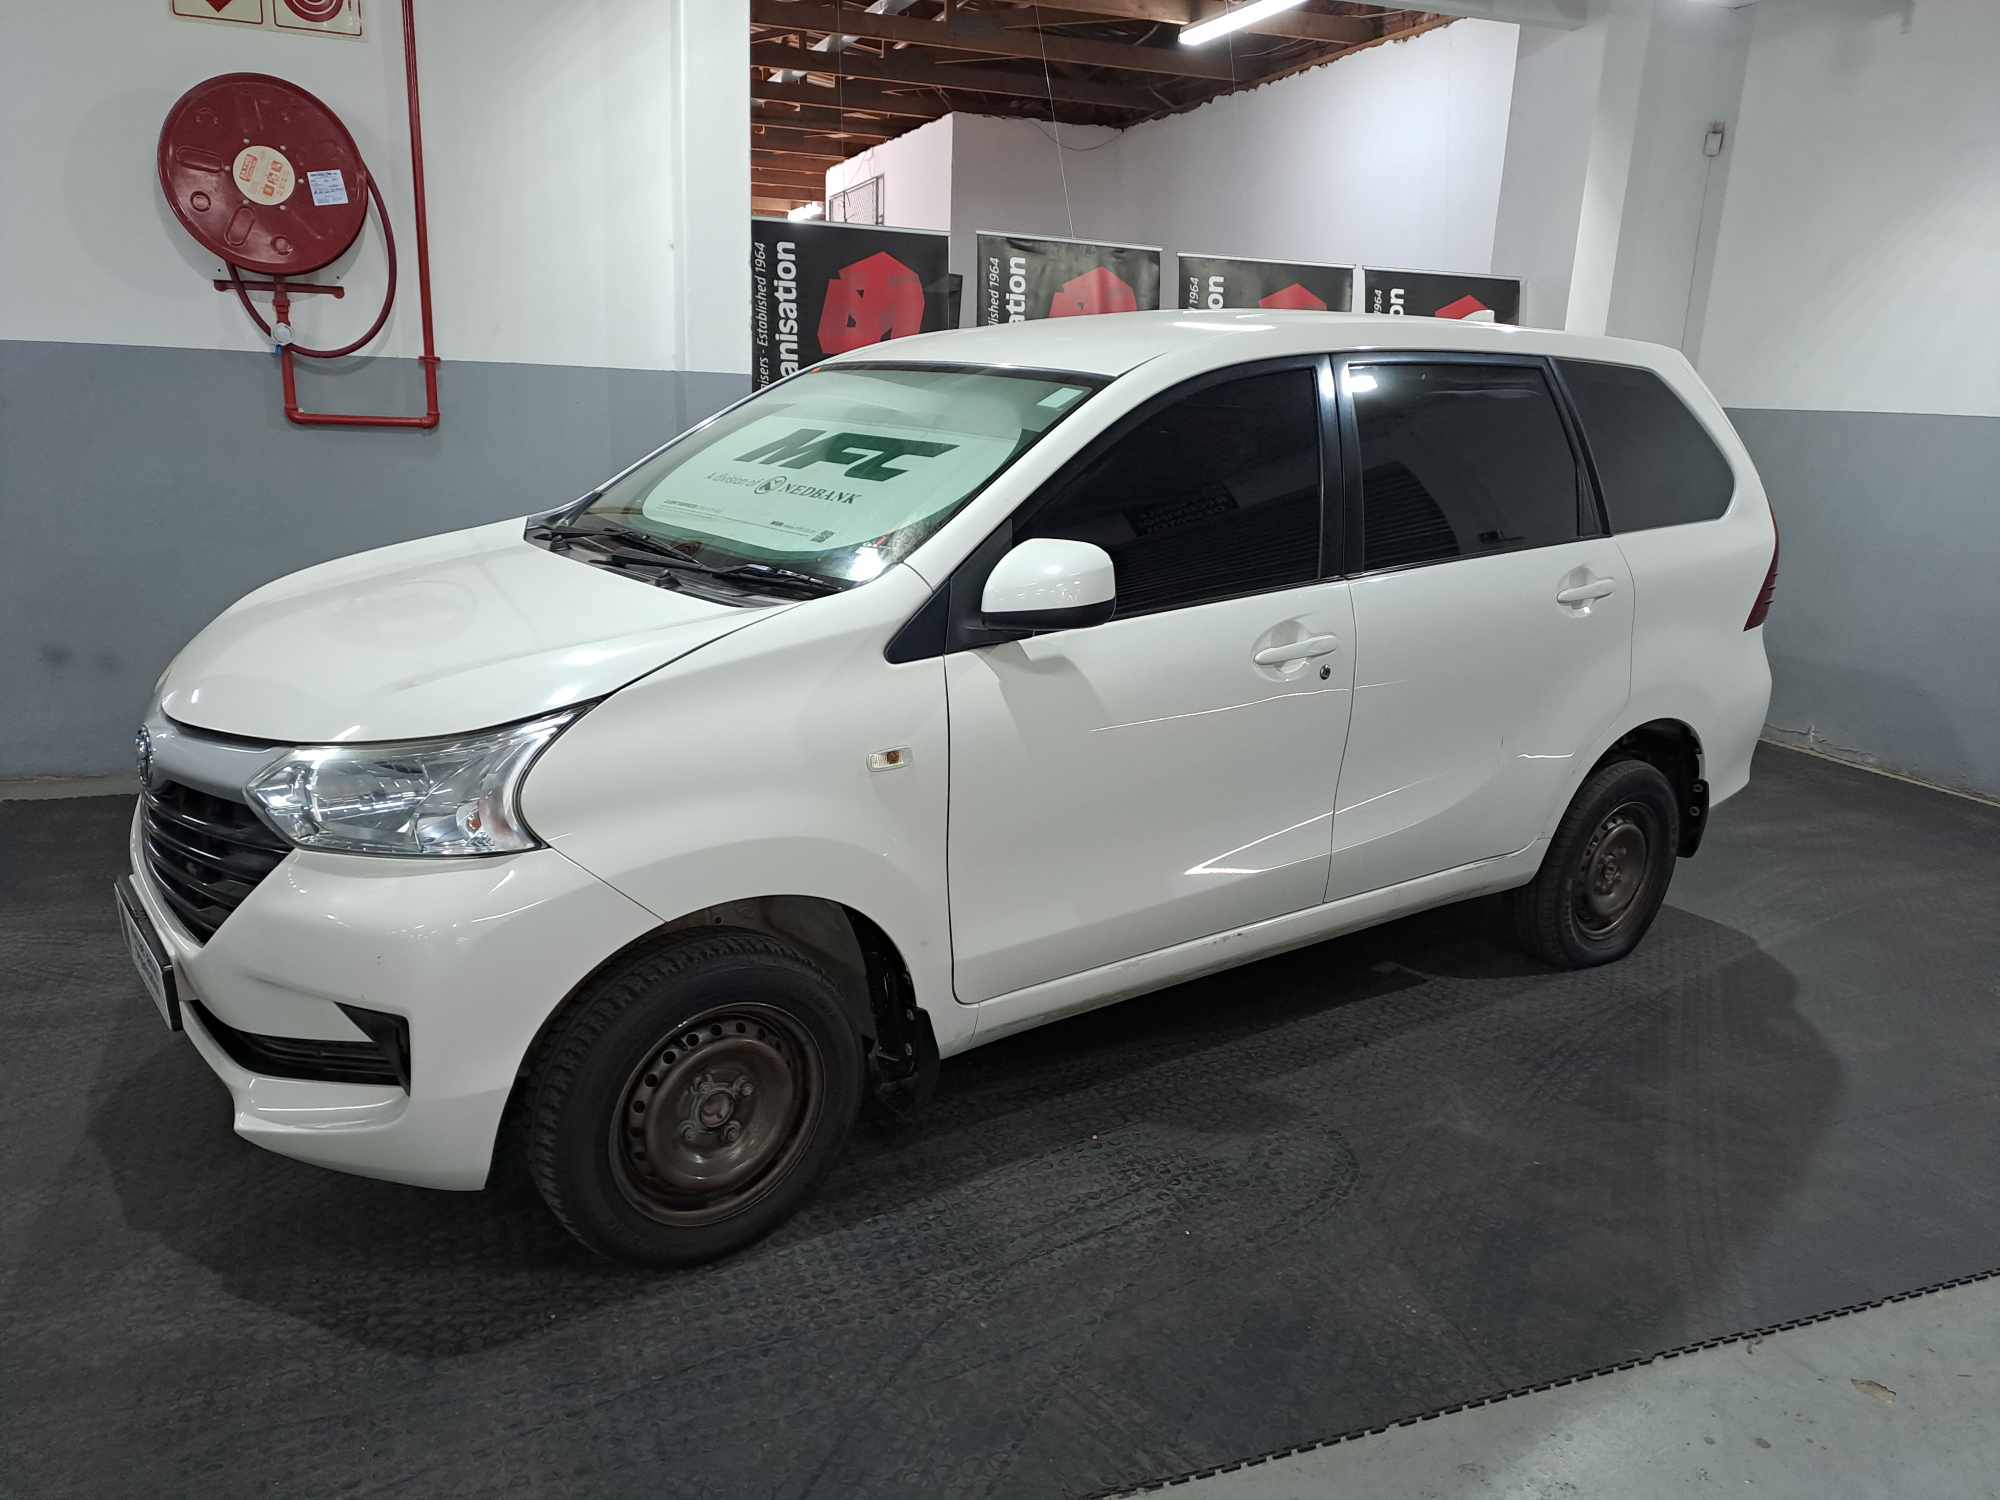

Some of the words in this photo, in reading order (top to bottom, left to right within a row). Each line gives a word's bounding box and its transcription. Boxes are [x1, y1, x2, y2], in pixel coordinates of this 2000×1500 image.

[754, 242, 767, 273] 1964
[989, 257, 1000, 287] 1964
[1189, 276, 1200, 304] 1964
[1208, 275, 1225, 309] on
[755, 275, 769, 347] Established
[733, 428, 960, 482] MFC
[778, 483, 862, 504] NEDBANK
